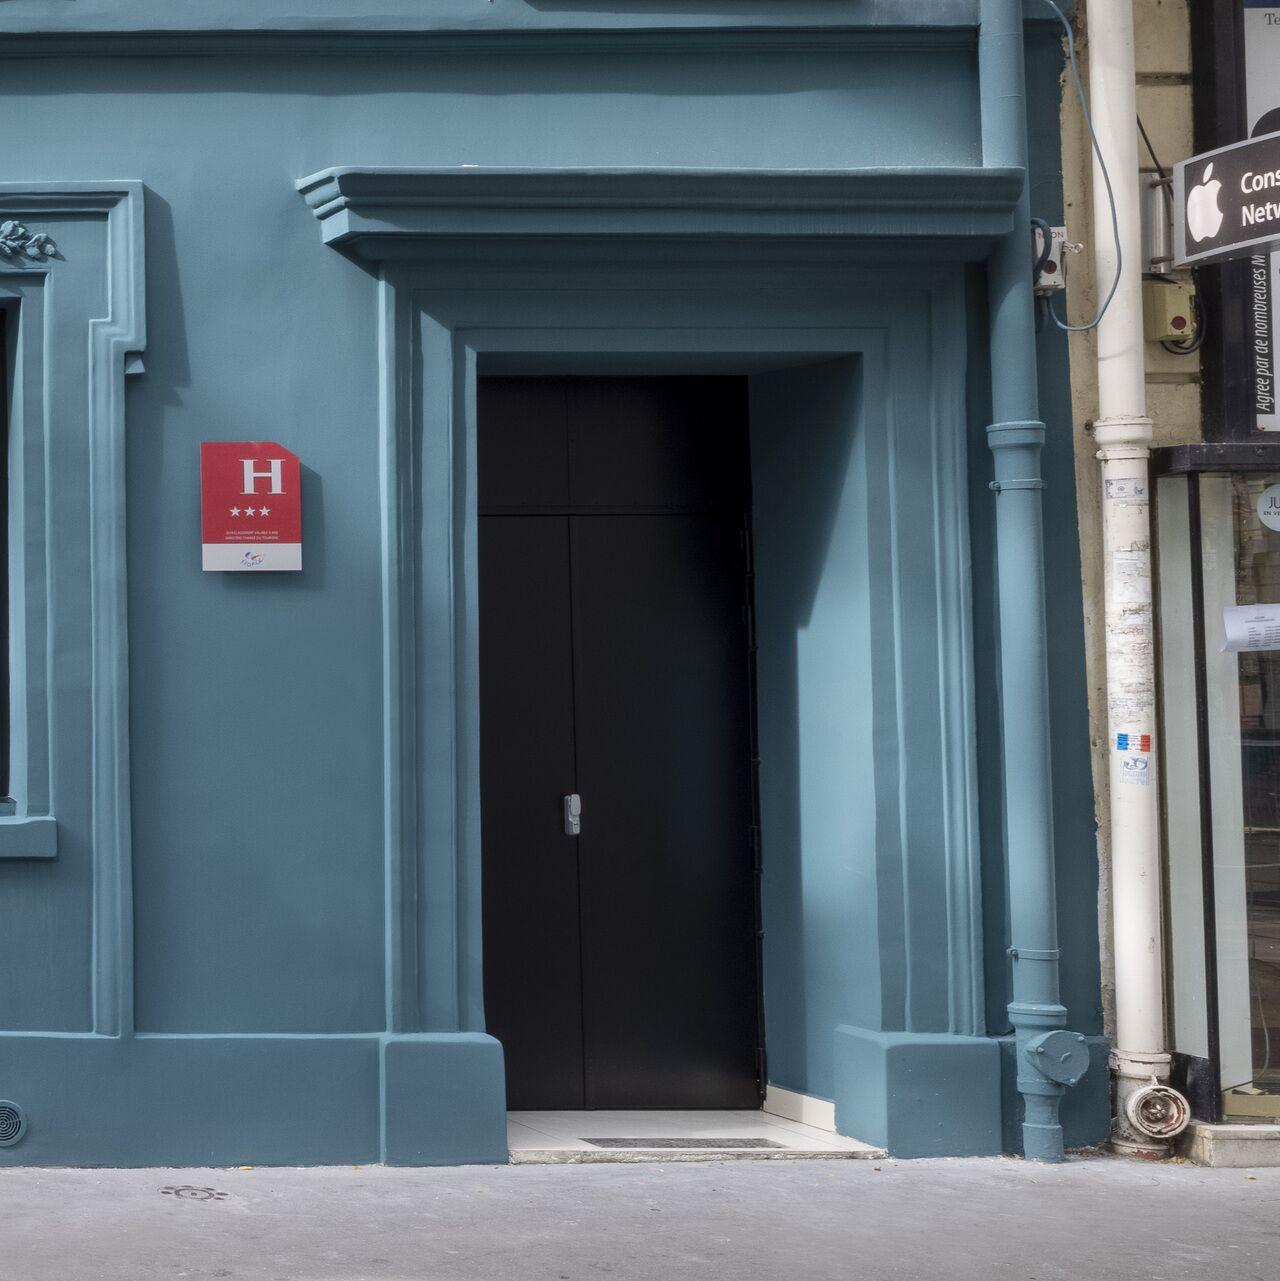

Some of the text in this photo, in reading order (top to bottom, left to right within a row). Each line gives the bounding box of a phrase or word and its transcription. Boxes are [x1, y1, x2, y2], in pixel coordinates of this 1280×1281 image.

[1251, 267, 1269, 338] nombreuses
[1254, 338, 1269, 354] de
[1256, 355, 1274, 377] par
[239, 458, 287, 495] H
